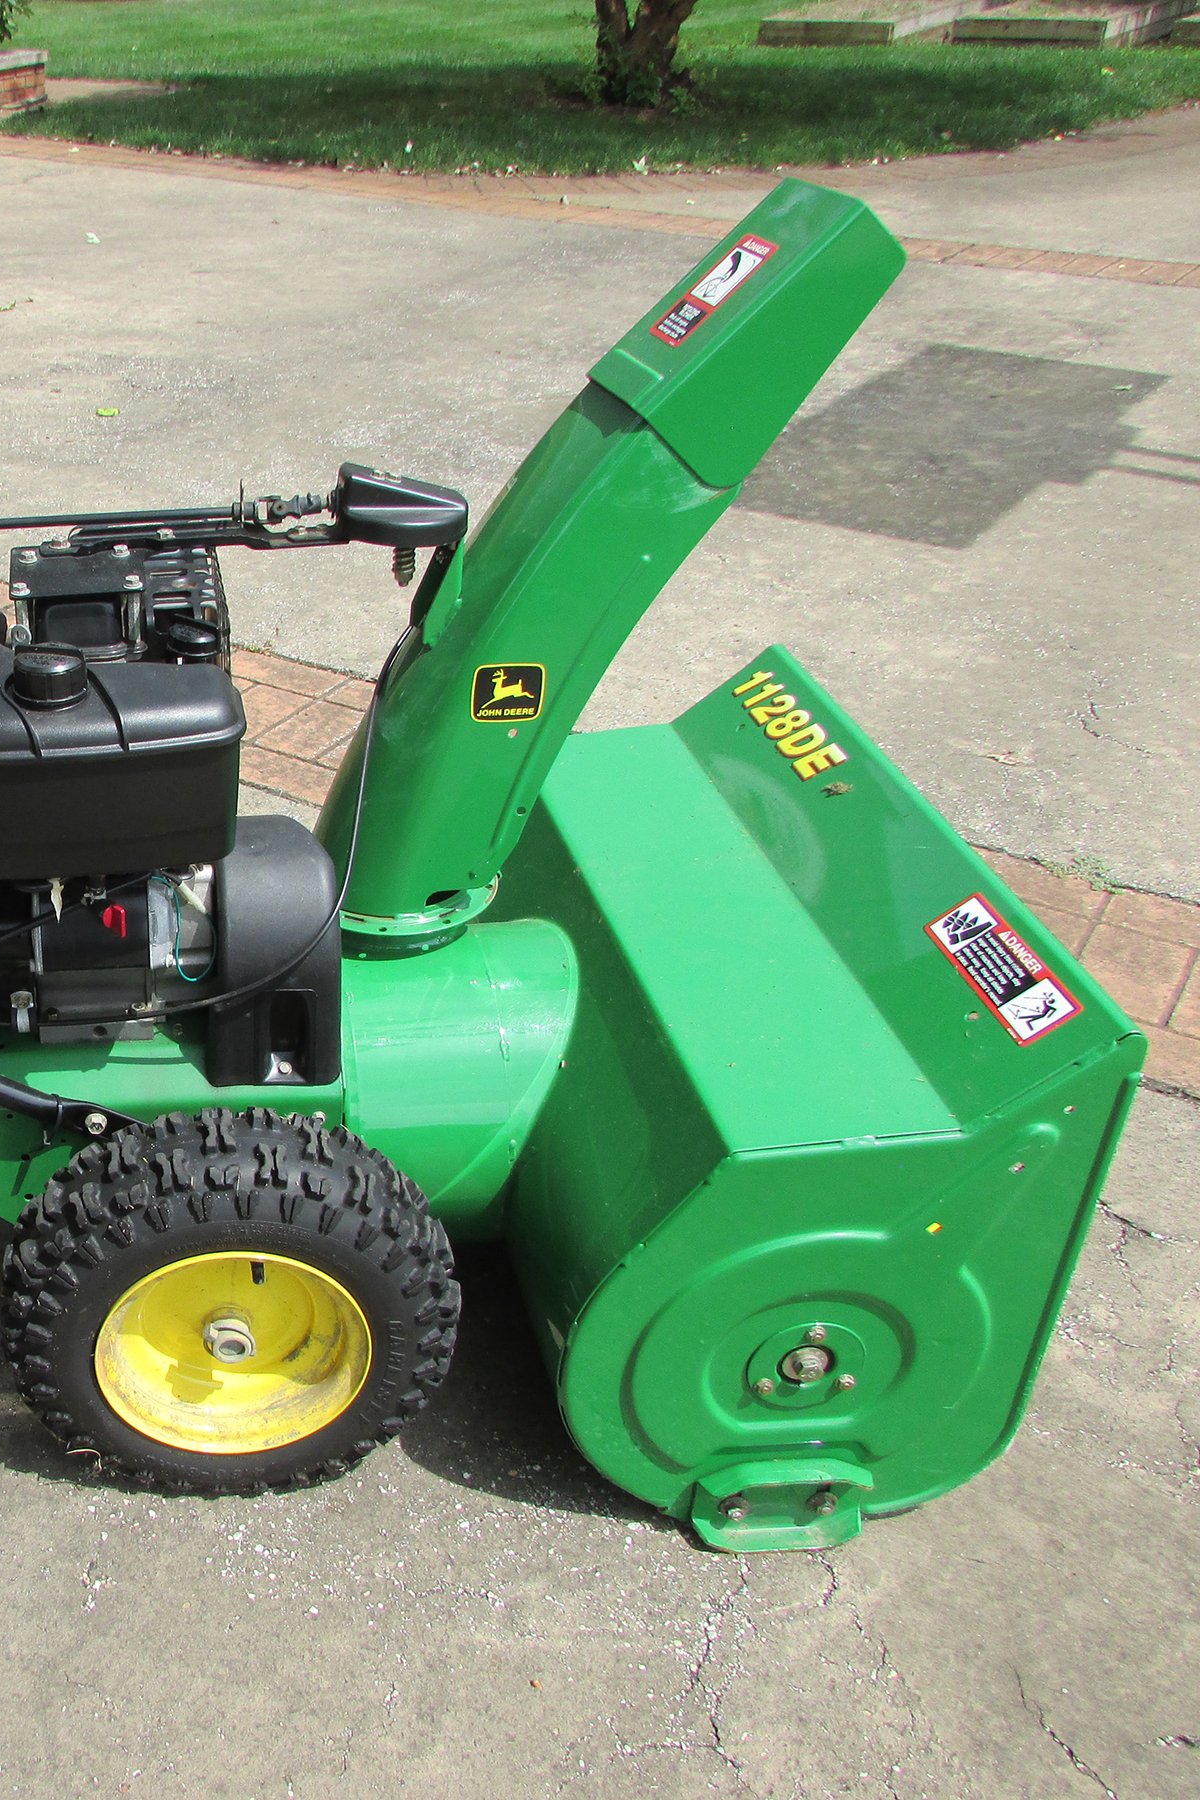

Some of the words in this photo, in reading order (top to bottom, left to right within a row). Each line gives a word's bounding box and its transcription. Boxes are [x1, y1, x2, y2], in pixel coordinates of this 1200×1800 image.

[476, 709, 503, 717] JOHN
[503, 707, 535, 716] DEERE
[732, 671, 849, 781] 1128DE
[1005, 934, 1042, 974] DANGER
